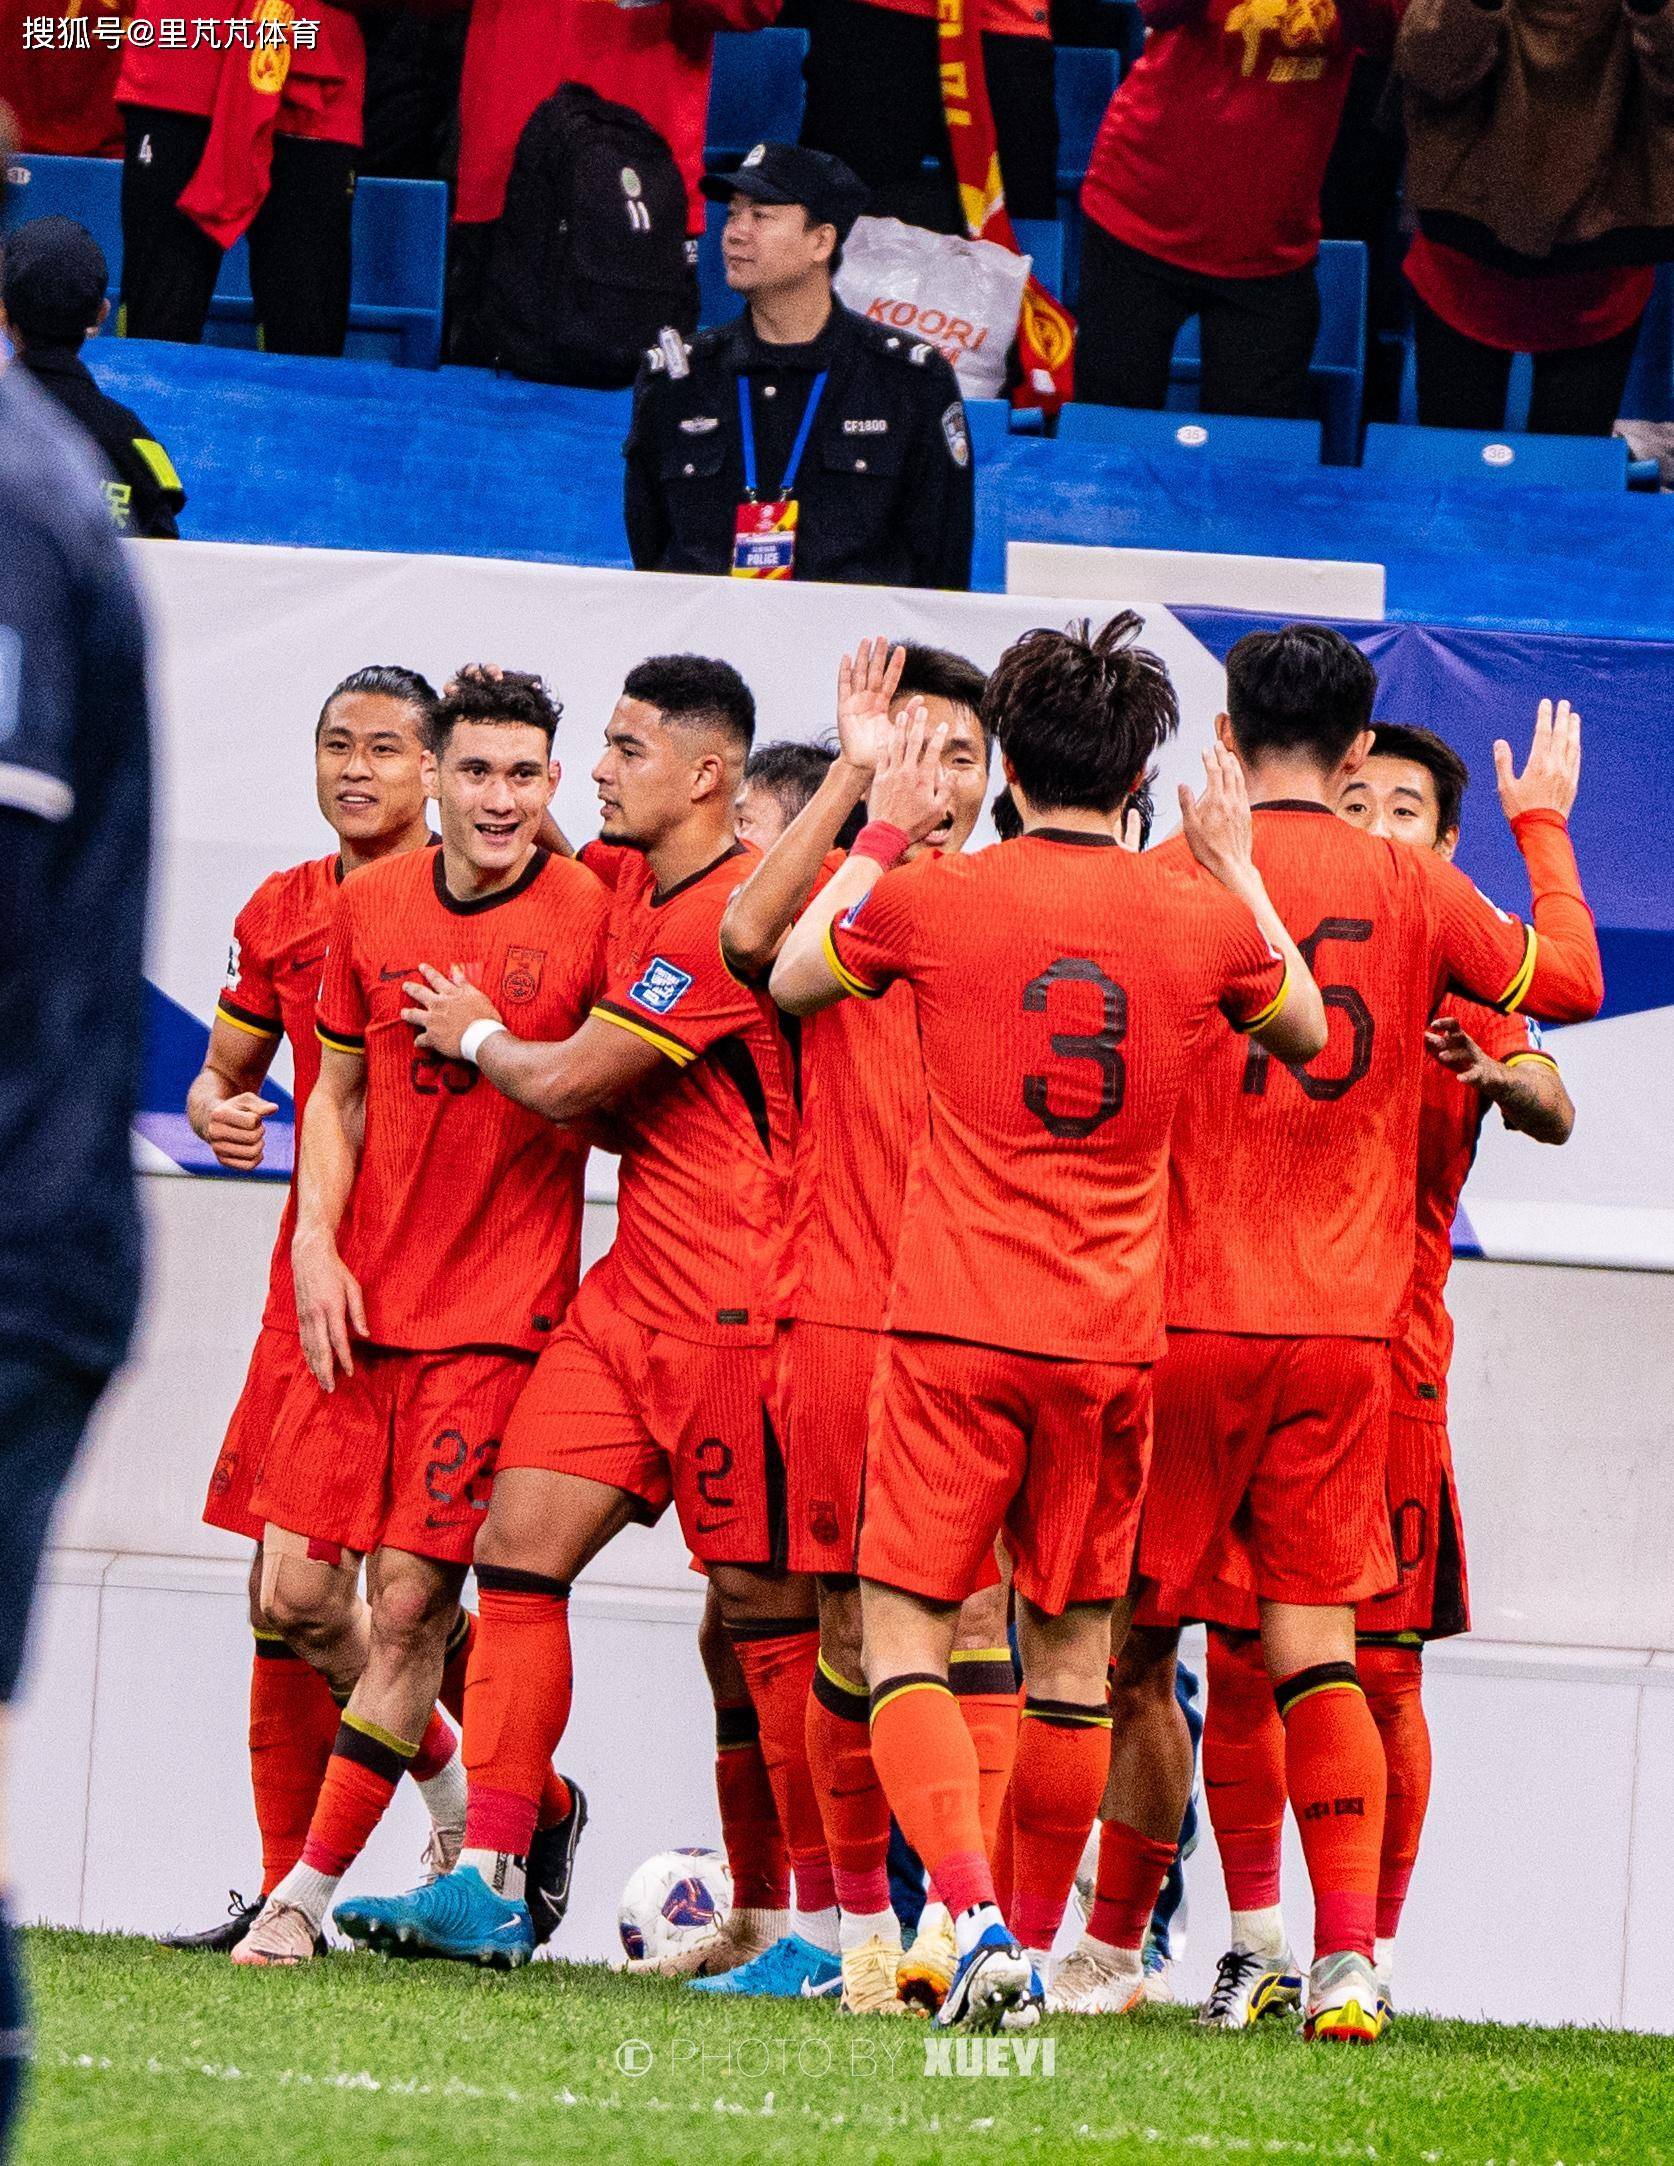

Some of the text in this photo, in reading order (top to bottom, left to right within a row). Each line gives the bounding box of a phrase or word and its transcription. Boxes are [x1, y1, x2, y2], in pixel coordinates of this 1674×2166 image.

[866, 297, 989, 353] KOORI
[746, 552, 780, 566] POLICE
[1022, 957, 1127, 1139] 3
[695, 1437, 734, 1507] 2
